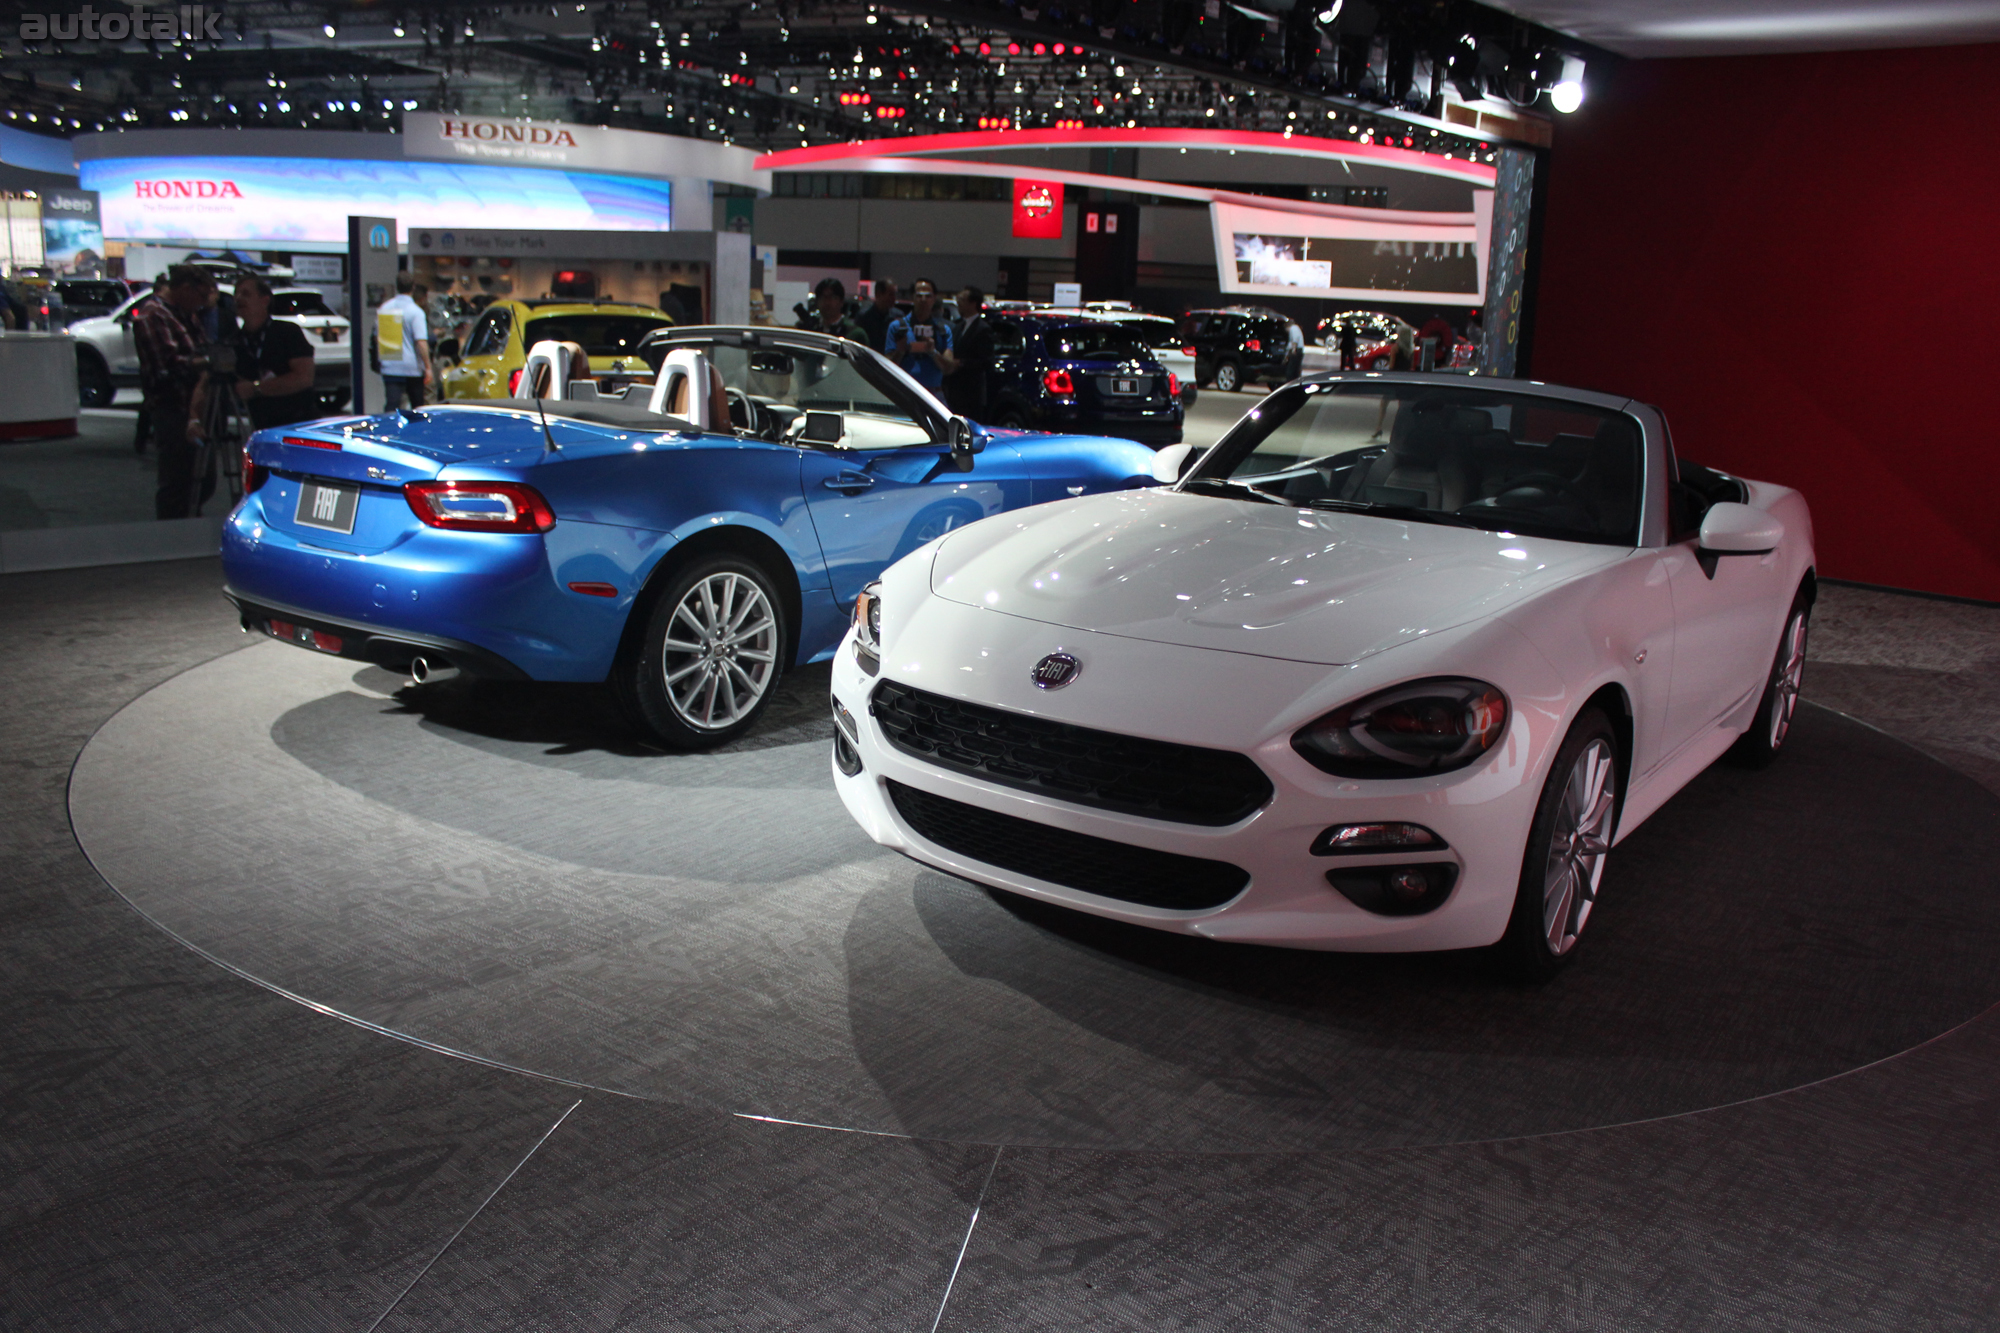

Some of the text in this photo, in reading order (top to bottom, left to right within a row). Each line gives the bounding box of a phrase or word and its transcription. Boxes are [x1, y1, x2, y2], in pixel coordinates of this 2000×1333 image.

[441, 119, 579, 148] HONDA
[134, 180, 244, 198] HONDA
[50, 194, 93, 214] Jeep
[312, 486, 342, 522] FIAT
[1039, 661, 1071, 680] FIAT
